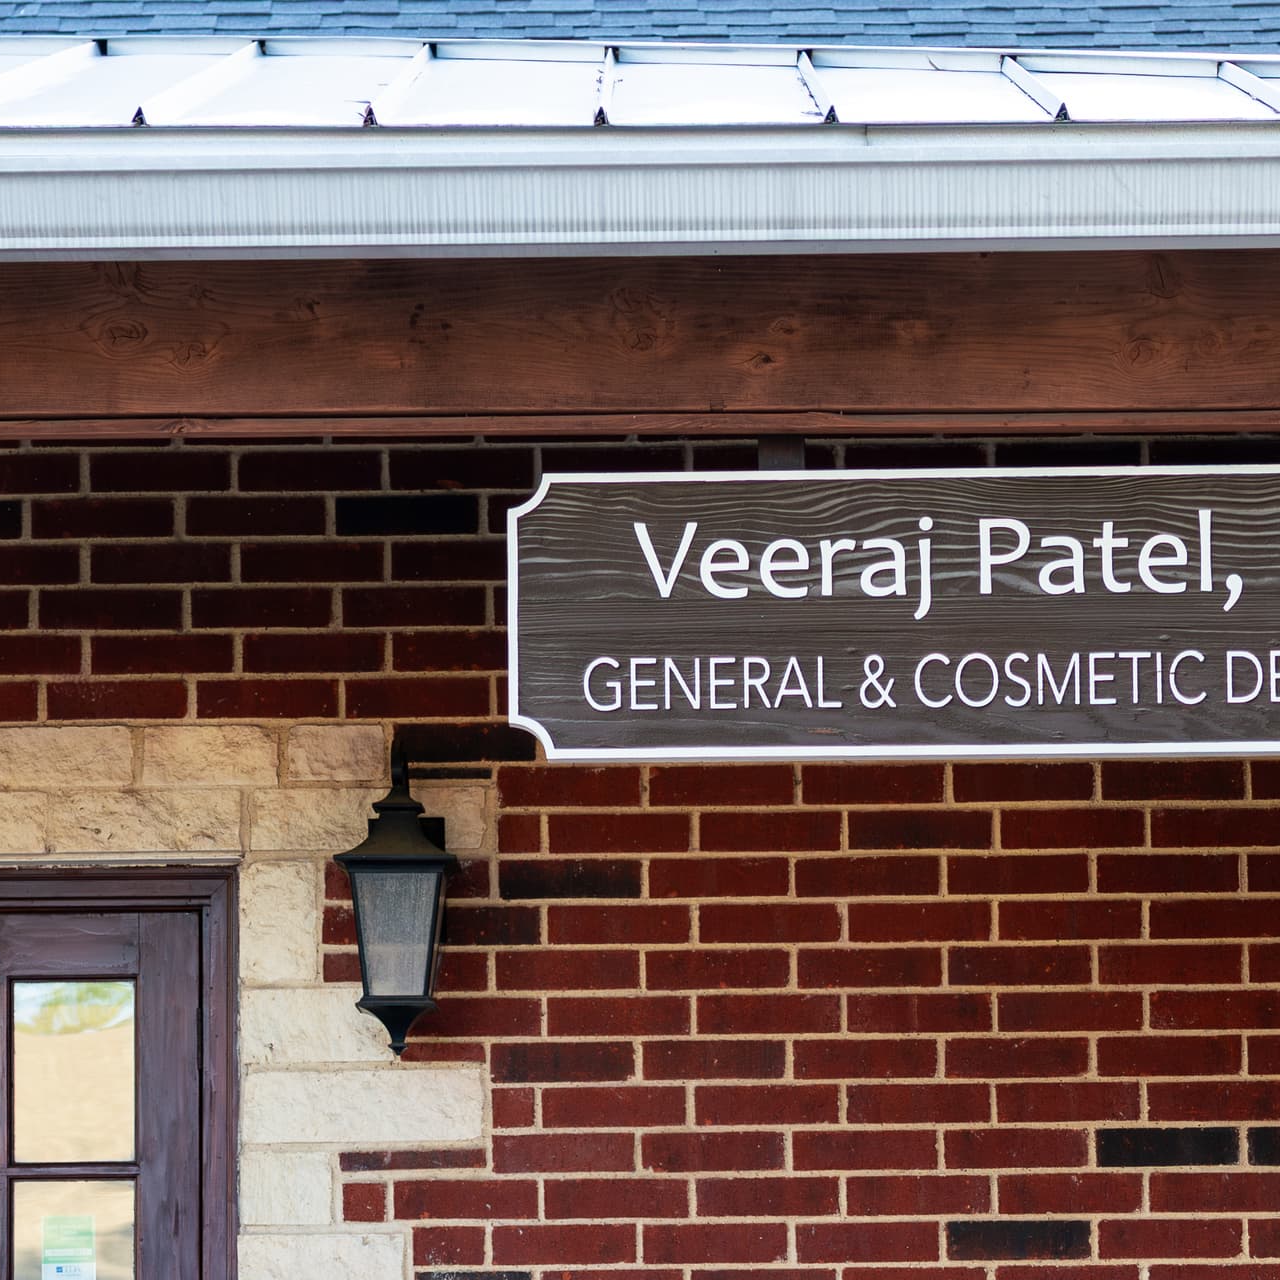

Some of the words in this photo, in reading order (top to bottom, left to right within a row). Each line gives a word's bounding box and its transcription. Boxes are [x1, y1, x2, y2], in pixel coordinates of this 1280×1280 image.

[632, 516, 933, 620] Veeraj
[978, 509, 1243, 612] Patel,
[582, 656, 842, 712] GENERAL
[858, 654, 897, 709] &
[914, 650, 1207, 708] COSMETIC
